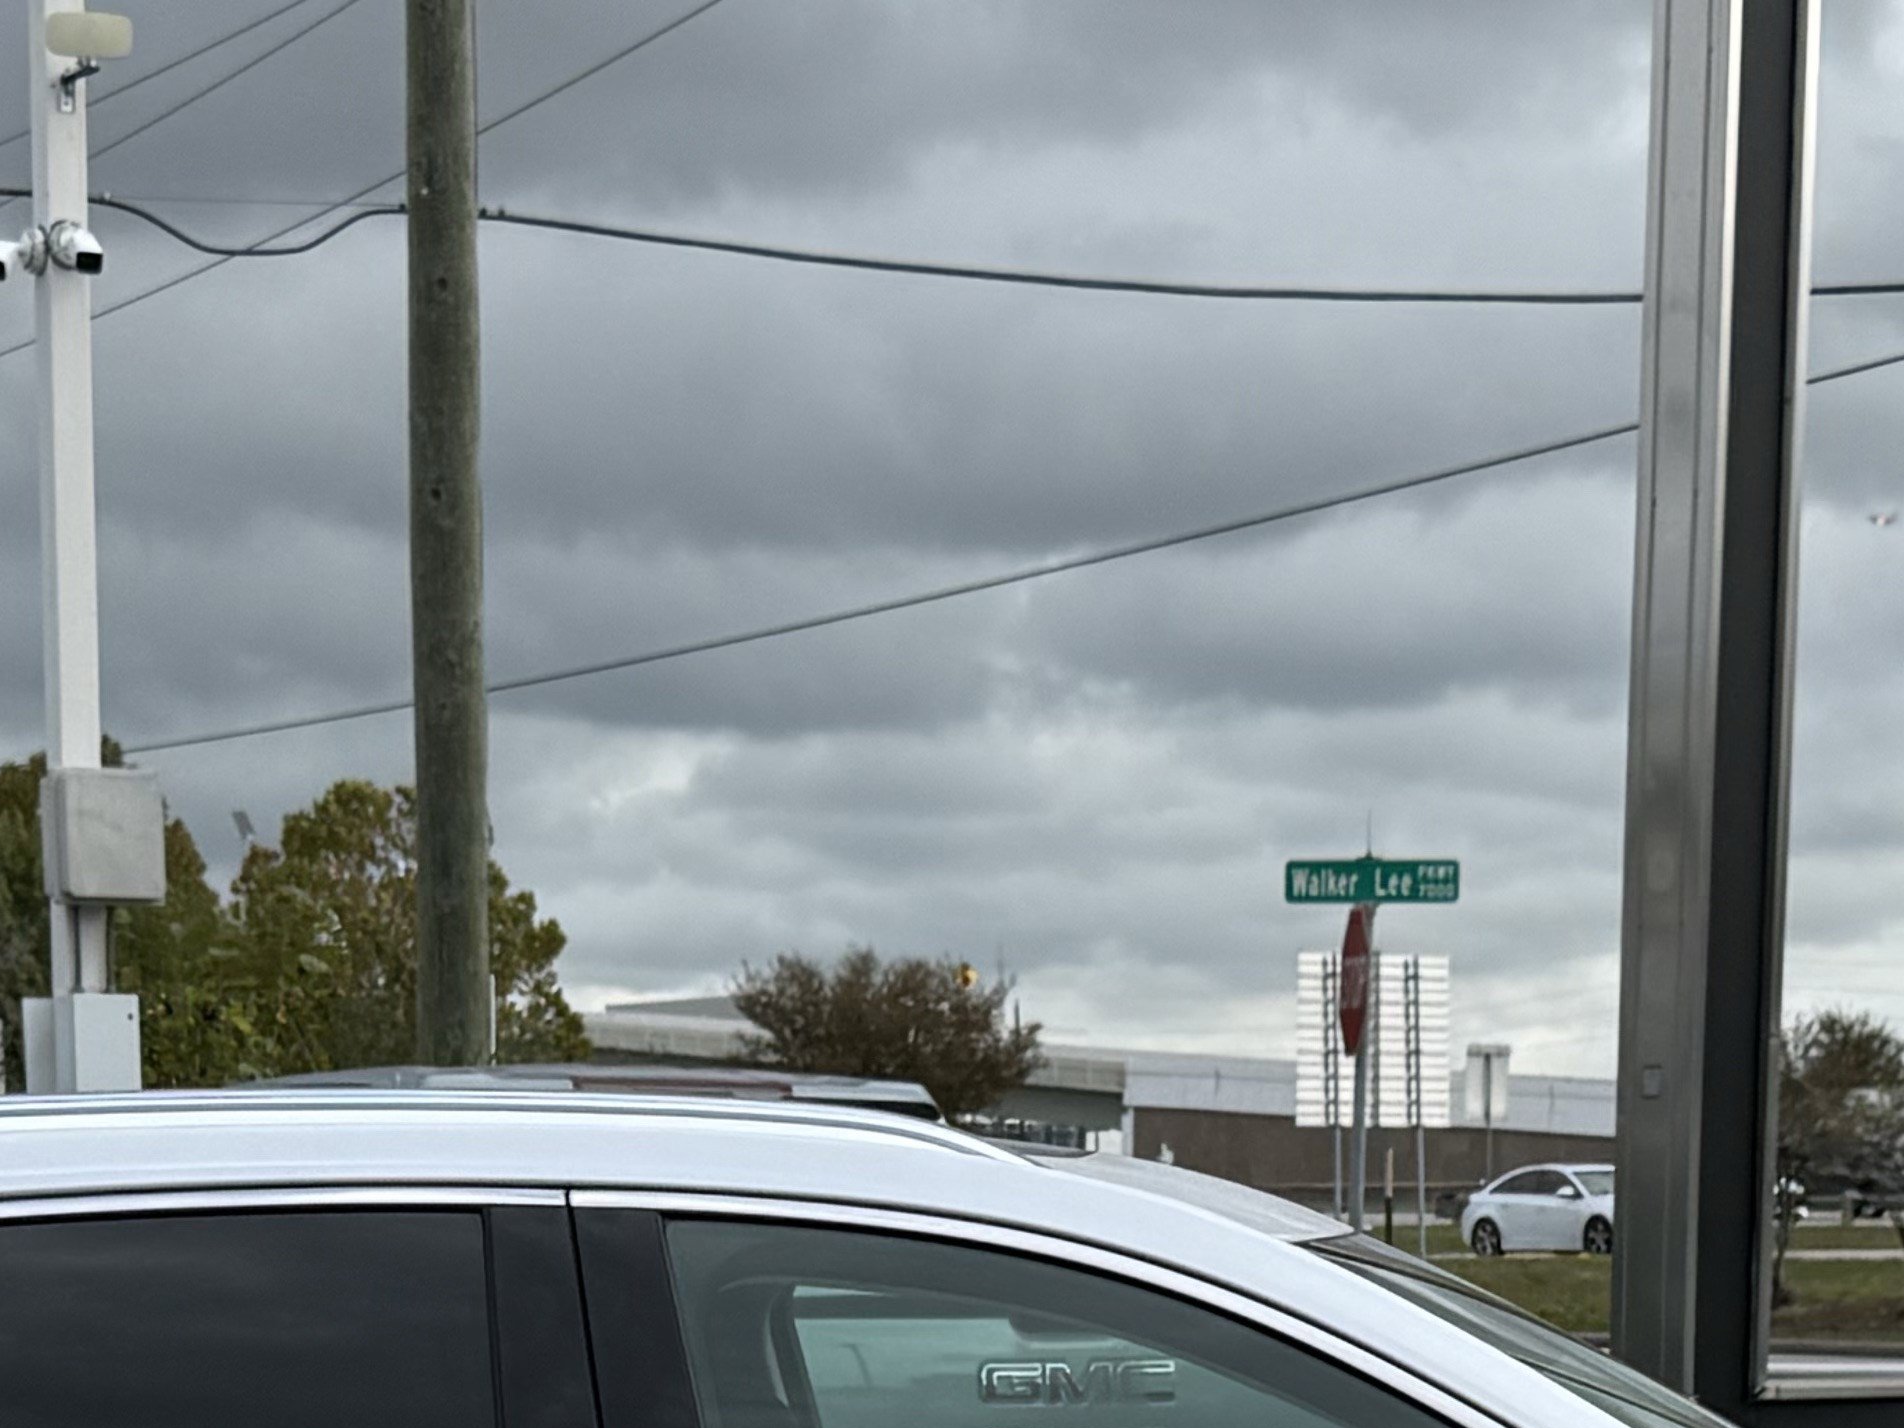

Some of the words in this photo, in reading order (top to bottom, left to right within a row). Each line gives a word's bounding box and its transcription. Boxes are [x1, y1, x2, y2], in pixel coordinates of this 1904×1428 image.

[1292, 866, 1359, 897] Walker
[1375, 866, 1412, 897] Lee
[980, 1359, 1176, 1405] GMC
